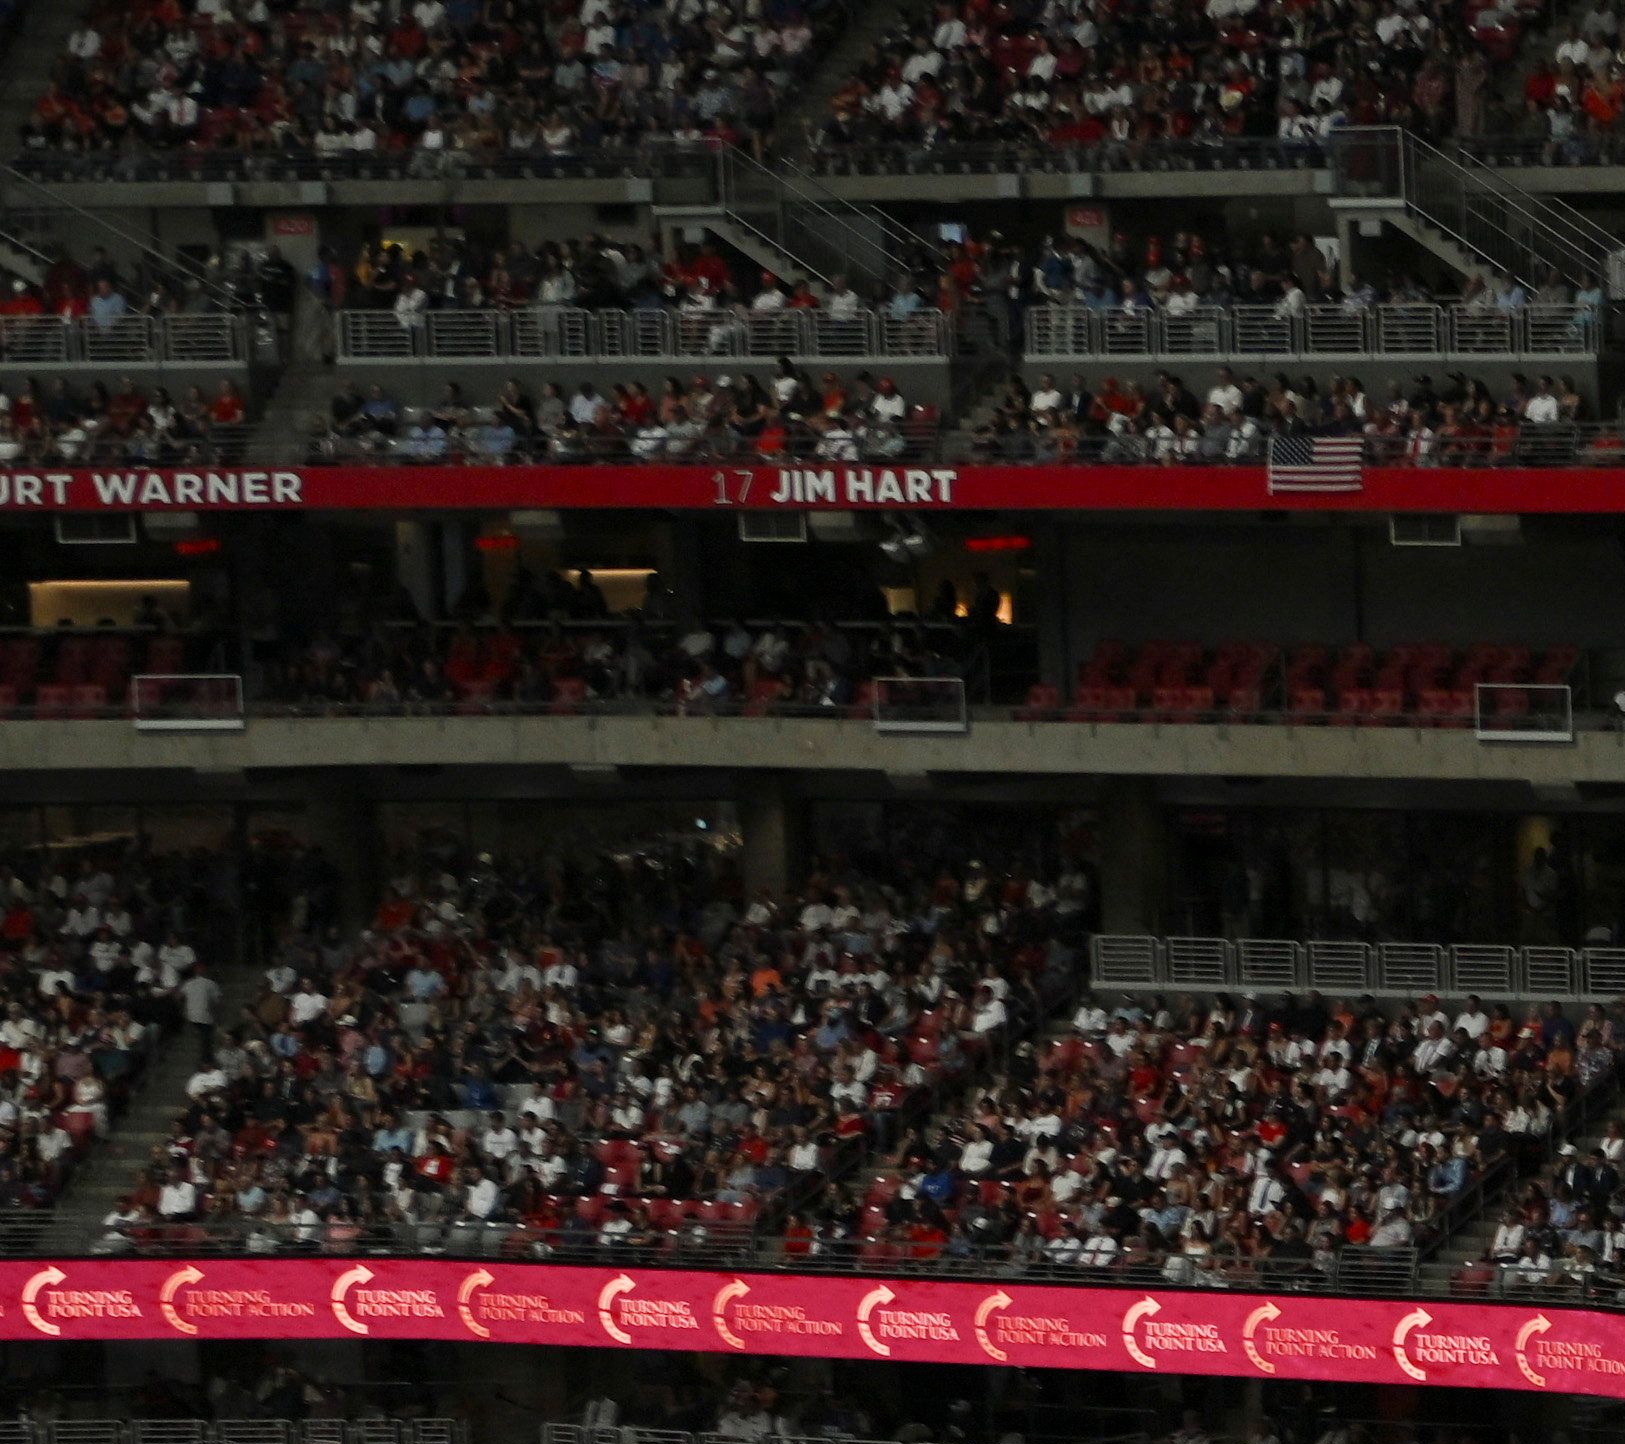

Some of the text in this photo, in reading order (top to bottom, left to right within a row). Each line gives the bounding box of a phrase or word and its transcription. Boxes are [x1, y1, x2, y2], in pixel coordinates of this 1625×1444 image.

[91, 472, 304, 505] WARNER
[711, 469, 958, 504] 17 JIM HART
[47, 1291, 132, 1305] TURNING
[186, 1290, 271, 1304] TURNING
[356, 1291, 436, 1305] TURNING
[478, 1293, 549, 1308] TURNING
[49, 1303, 143, 1318] POINT USA
[186, 1303, 314, 1316] POINT ACTION
[356, 1303, 444, 1318] POINT USA
[479, 1306, 585, 1323] POINT ACTION
[619, 1300, 690, 1315] TURNING
[734, 1305, 805, 1320] TURNING
[621, 1312, 700, 1329] POINT USA
[735, 1318, 841, 1335] POINT ACTION
[878, 1311, 950, 1327] TURNING
[997, 1316, 1069, 1332] TURNING
[880, 1324, 960, 1341] POINT USA
[998, 1329, 1107, 1347] POINT ACTION
[1144, 1322, 1218, 1339] TURNING
[1265, 1328, 1339, 1344] TURNING
[1146, 1335, 1227, 1354] POINT USA
[1415, 1334, 1490, 1351] TURNING
[1536, 1340, 1601, 1358] TURNING
[1266, 1342, 1376, 1360] POINT ACTION
[1416, 1347, 1499, 1366] POINT USA
[1537, 1354, 1582, 1370] POINT
